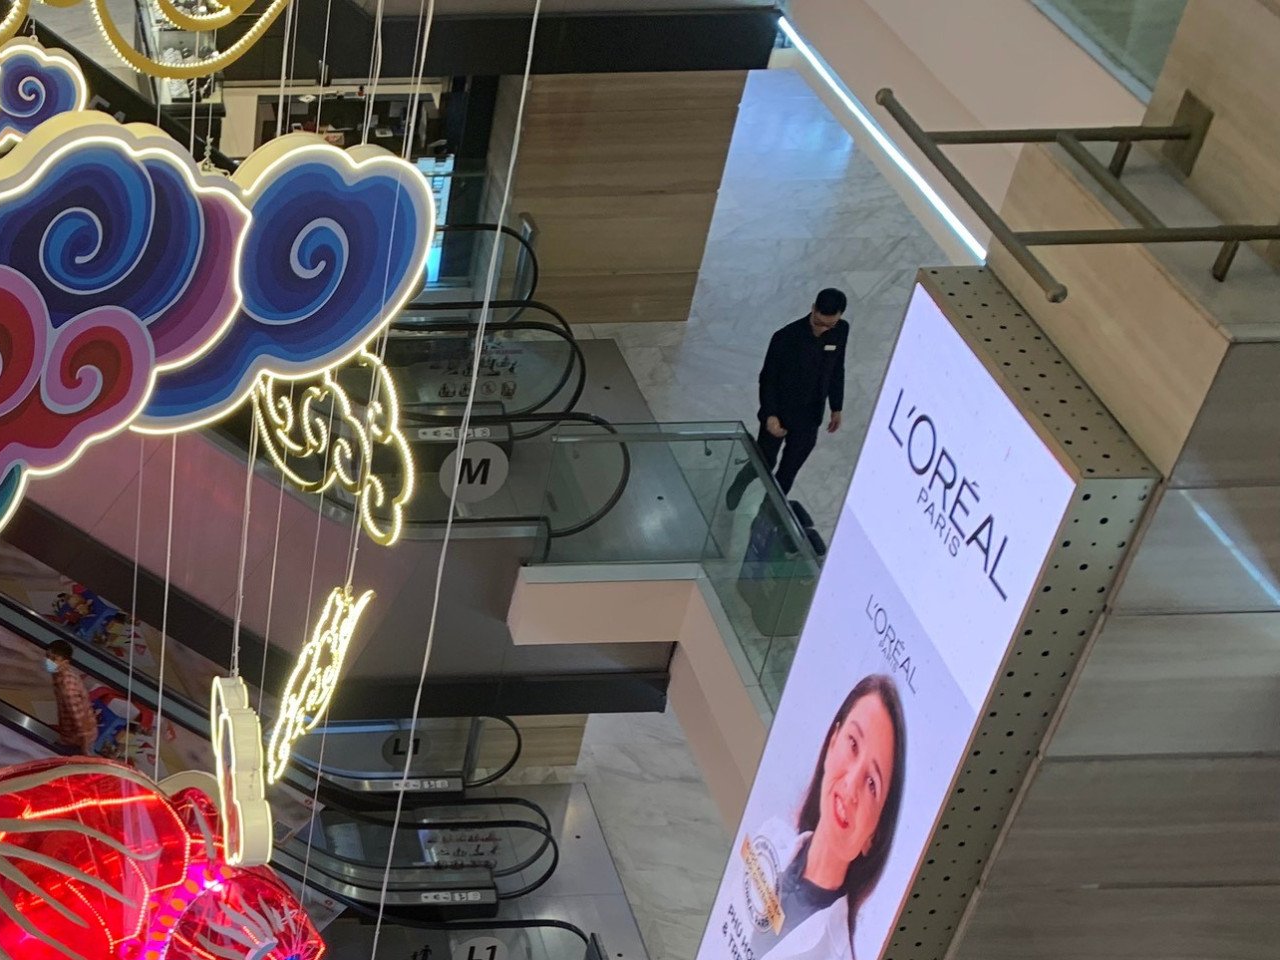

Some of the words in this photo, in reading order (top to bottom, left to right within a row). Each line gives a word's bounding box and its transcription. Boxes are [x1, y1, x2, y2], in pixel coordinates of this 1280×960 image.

[458, 457, 491, 485] M
[888, 388, 1008, 602] L'ORÉAL
[917, 487, 960, 557] PARIS
[866, 594, 916, 694] L'ORÉAL
